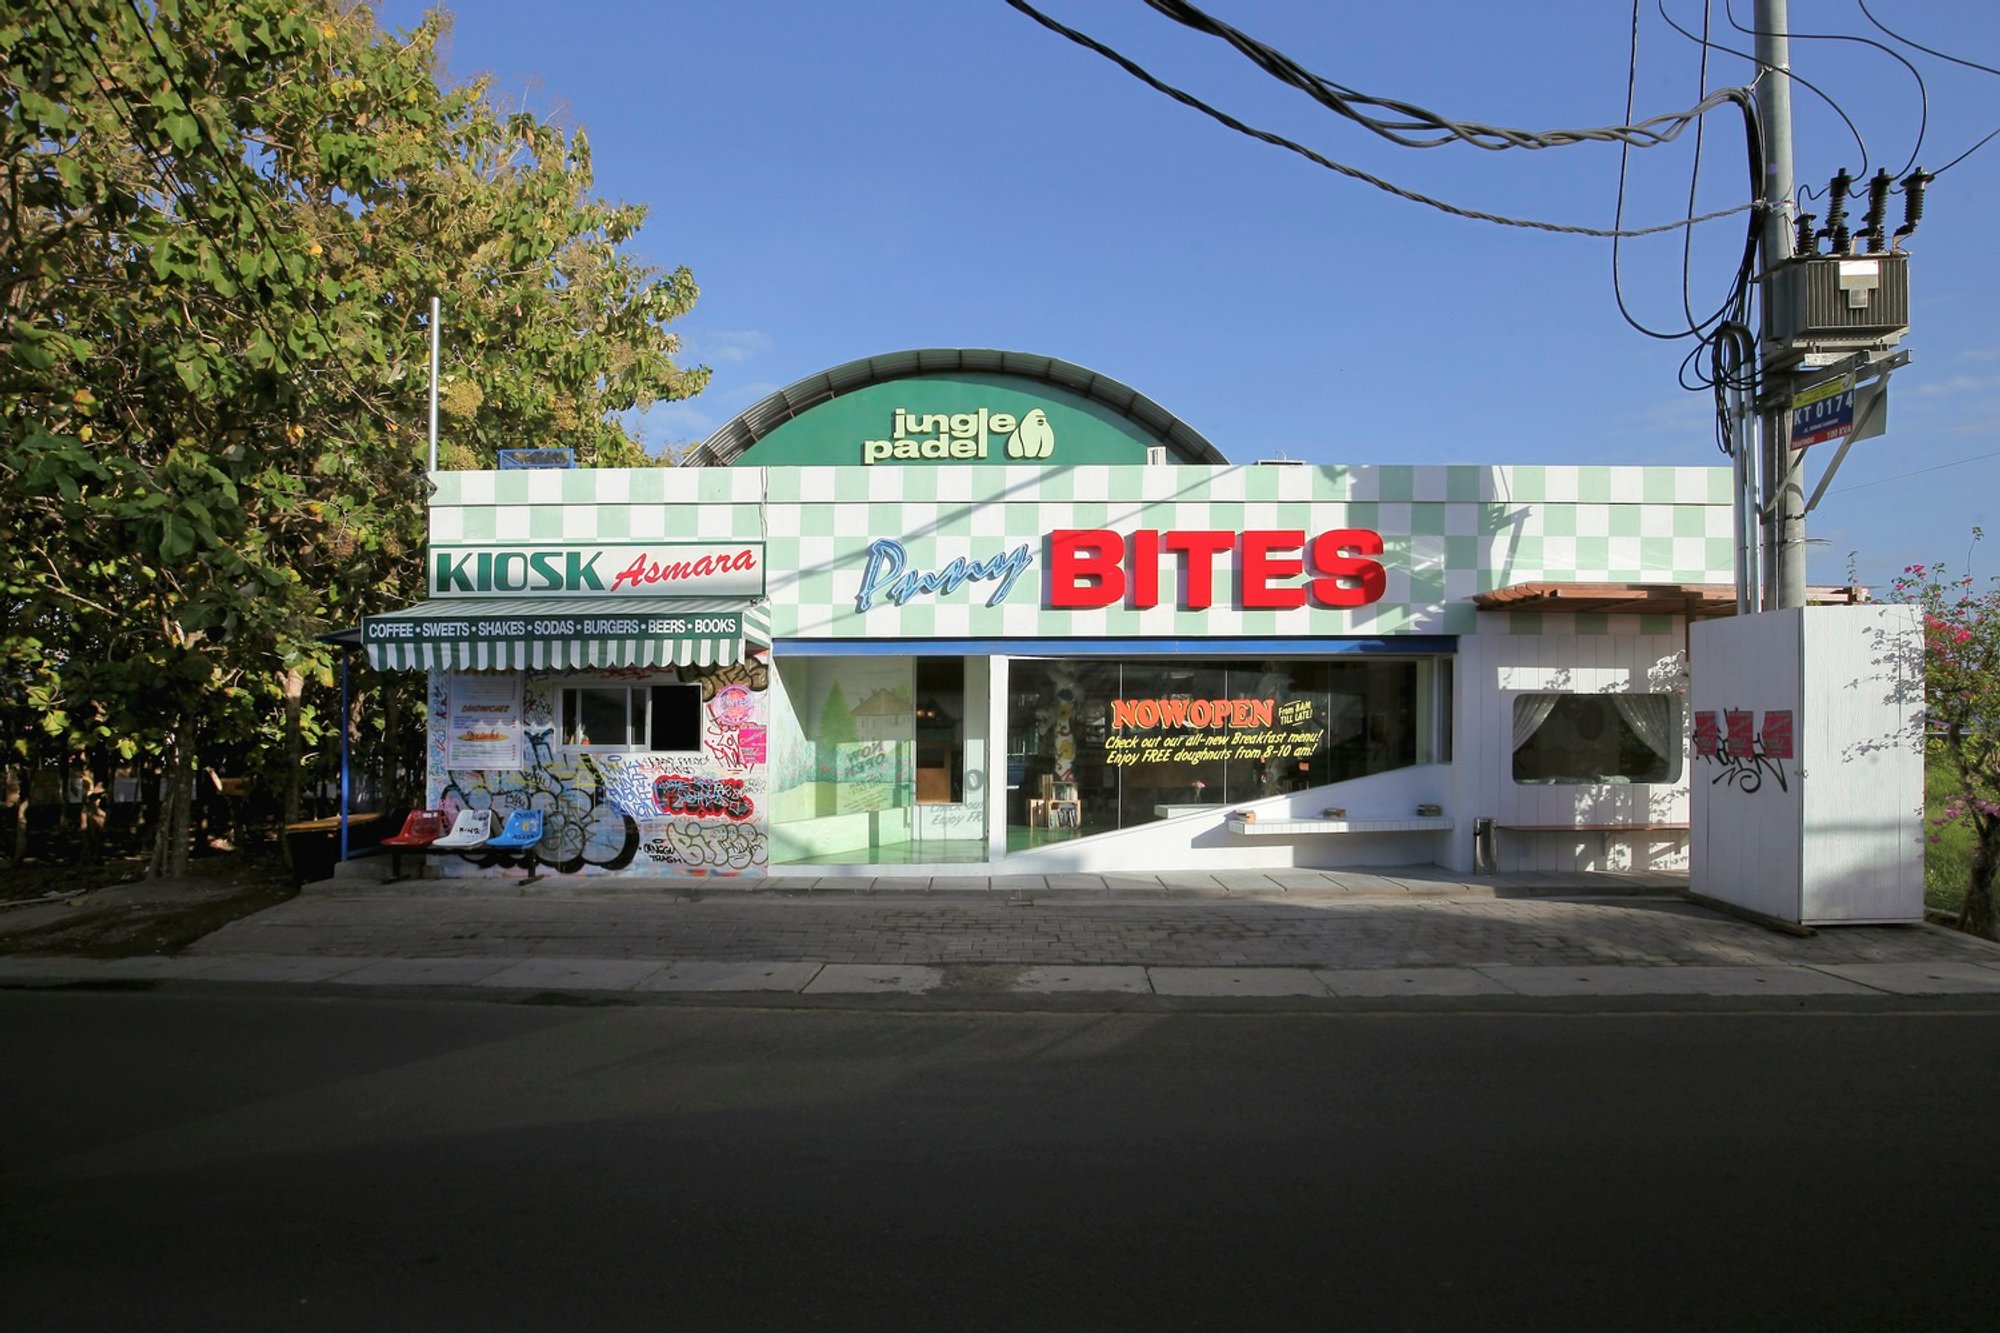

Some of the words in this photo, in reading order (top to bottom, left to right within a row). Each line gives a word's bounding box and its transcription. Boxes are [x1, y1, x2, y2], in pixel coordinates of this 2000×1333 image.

[893, 408, 1016, 438] jungle
[1794, 405, 1811, 425] KT
[1816, 392, 1853, 418] 0174
[864, 432, 988, 464] padel
[436, 551, 605, 592] KIOSK
[611, 549, 757, 592] Asmara
[1046, 529, 1387, 610] BITES
[368, 623, 414, 638] COFFEE
[422, 622, 470, 637] SWEETS
[478, 621, 525, 636] SHAKES
[533, 620, 575, 635] SODAS
[583, 620, 639, 635] BURGERS
[648, 619, 686, 634] BEERS
[694, 619, 736, 633] BOOKS
[1111, 699, 1190, 729] NOW
[1188, 699, 1275, 729] OPEN
[1105, 735, 1137, 749] Check
[1141, 735, 1159, 748] out
[1163, 735, 1182, 747] our
[1185, 733, 1231, 746] all-new
[1231, 731, 1287, 745] Breakfast
[1289, 729, 1324, 745] menu!
[1106, 750, 1139, 766] Enjoy
[1142, 750, 1171, 763] FREE
[1174, 748, 1230, 765] doughnuts
[1234, 746, 1261, 760] from
[1264, 745, 1291, 758] 8-10
[1293, 743, 1316, 757] am!
